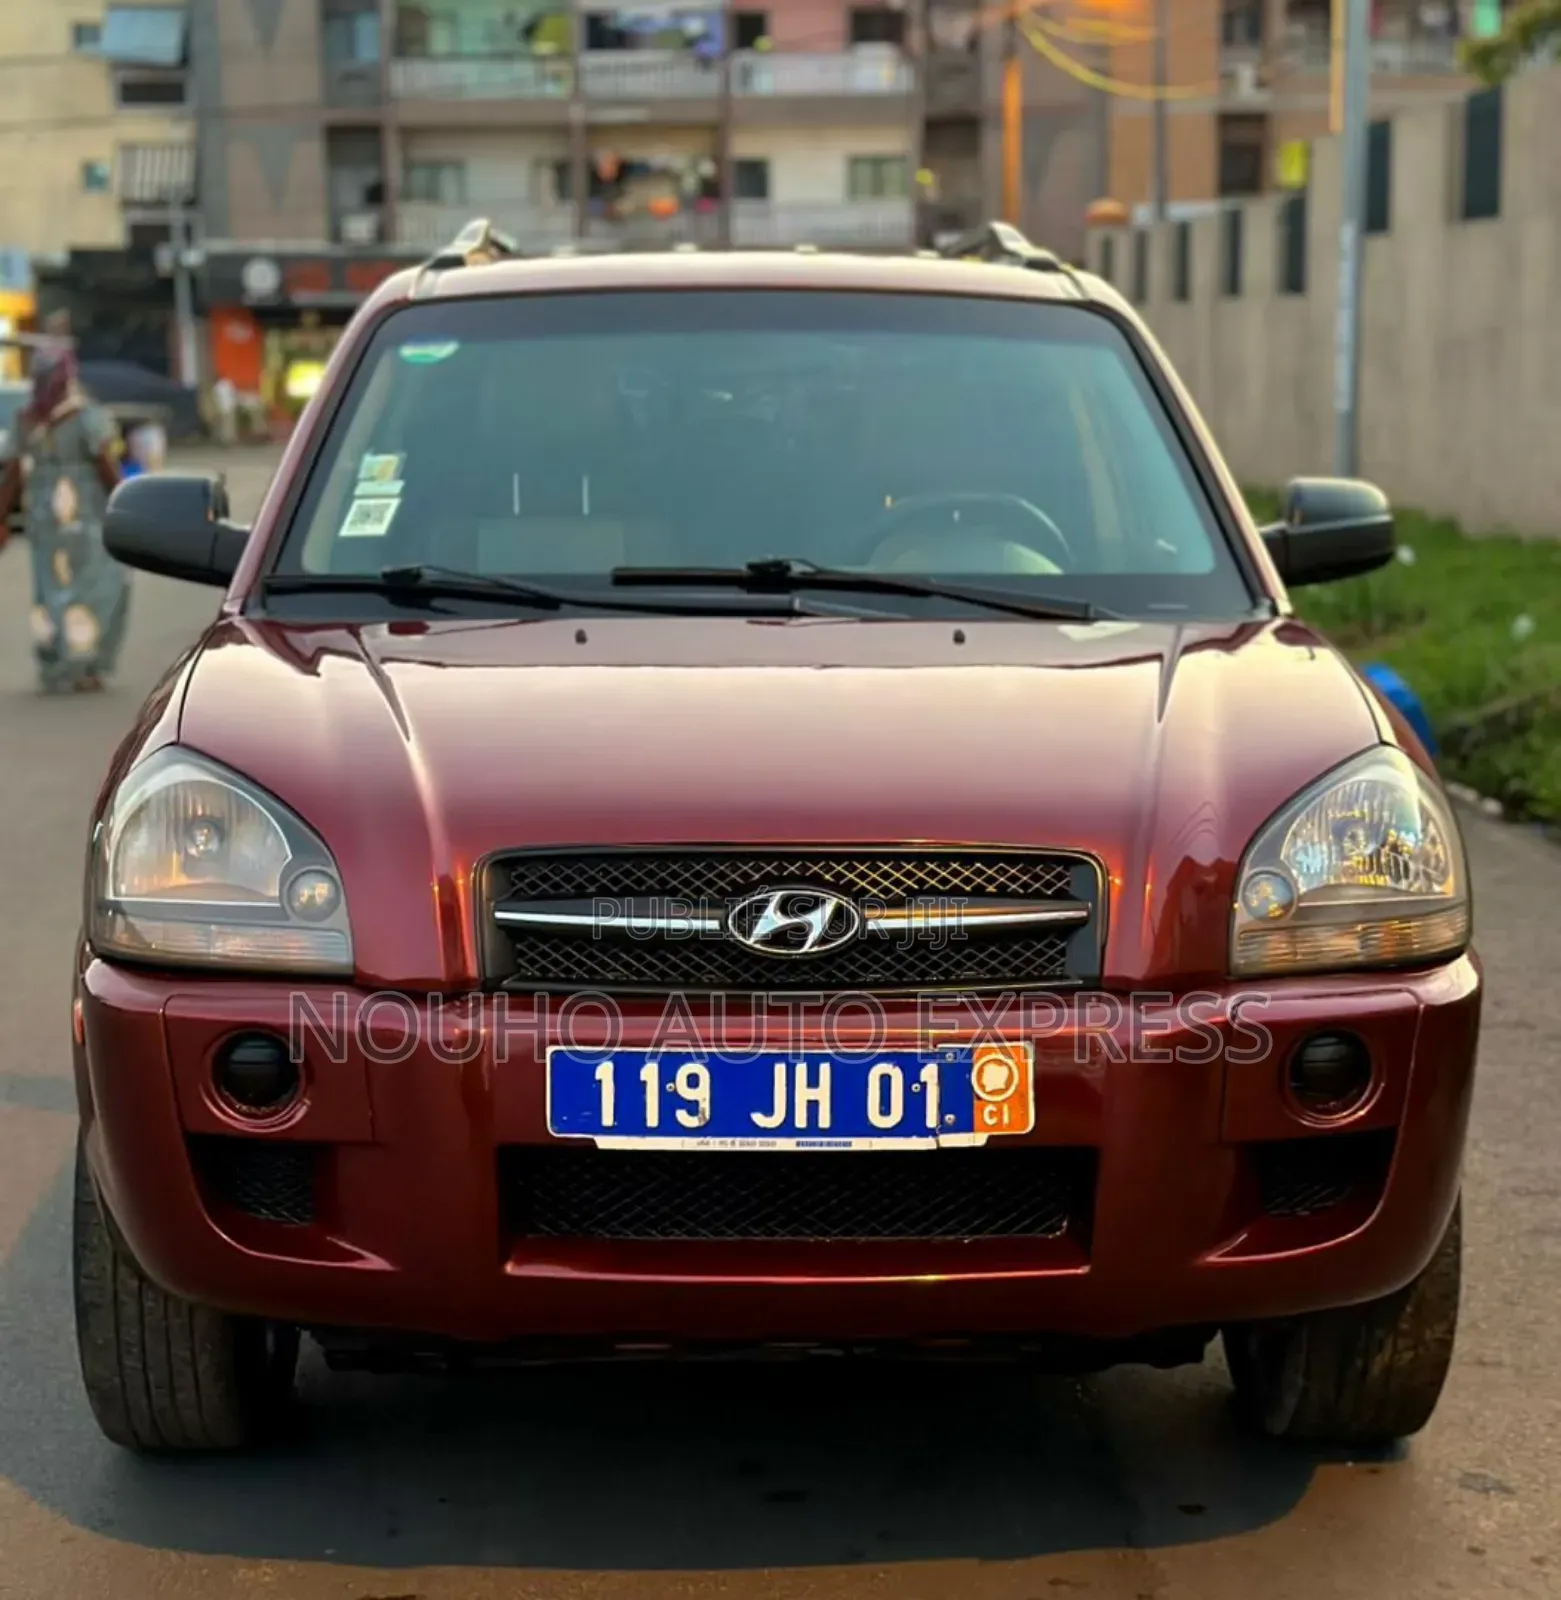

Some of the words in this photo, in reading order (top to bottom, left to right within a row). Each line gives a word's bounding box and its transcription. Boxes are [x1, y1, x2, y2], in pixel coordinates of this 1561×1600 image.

[594, 1060, 712, 1129] 119
[749, 1060, 832, 1129] JH
[867, 1061, 941, 1129] 01
[982, 1104, 1010, 1126] CI
